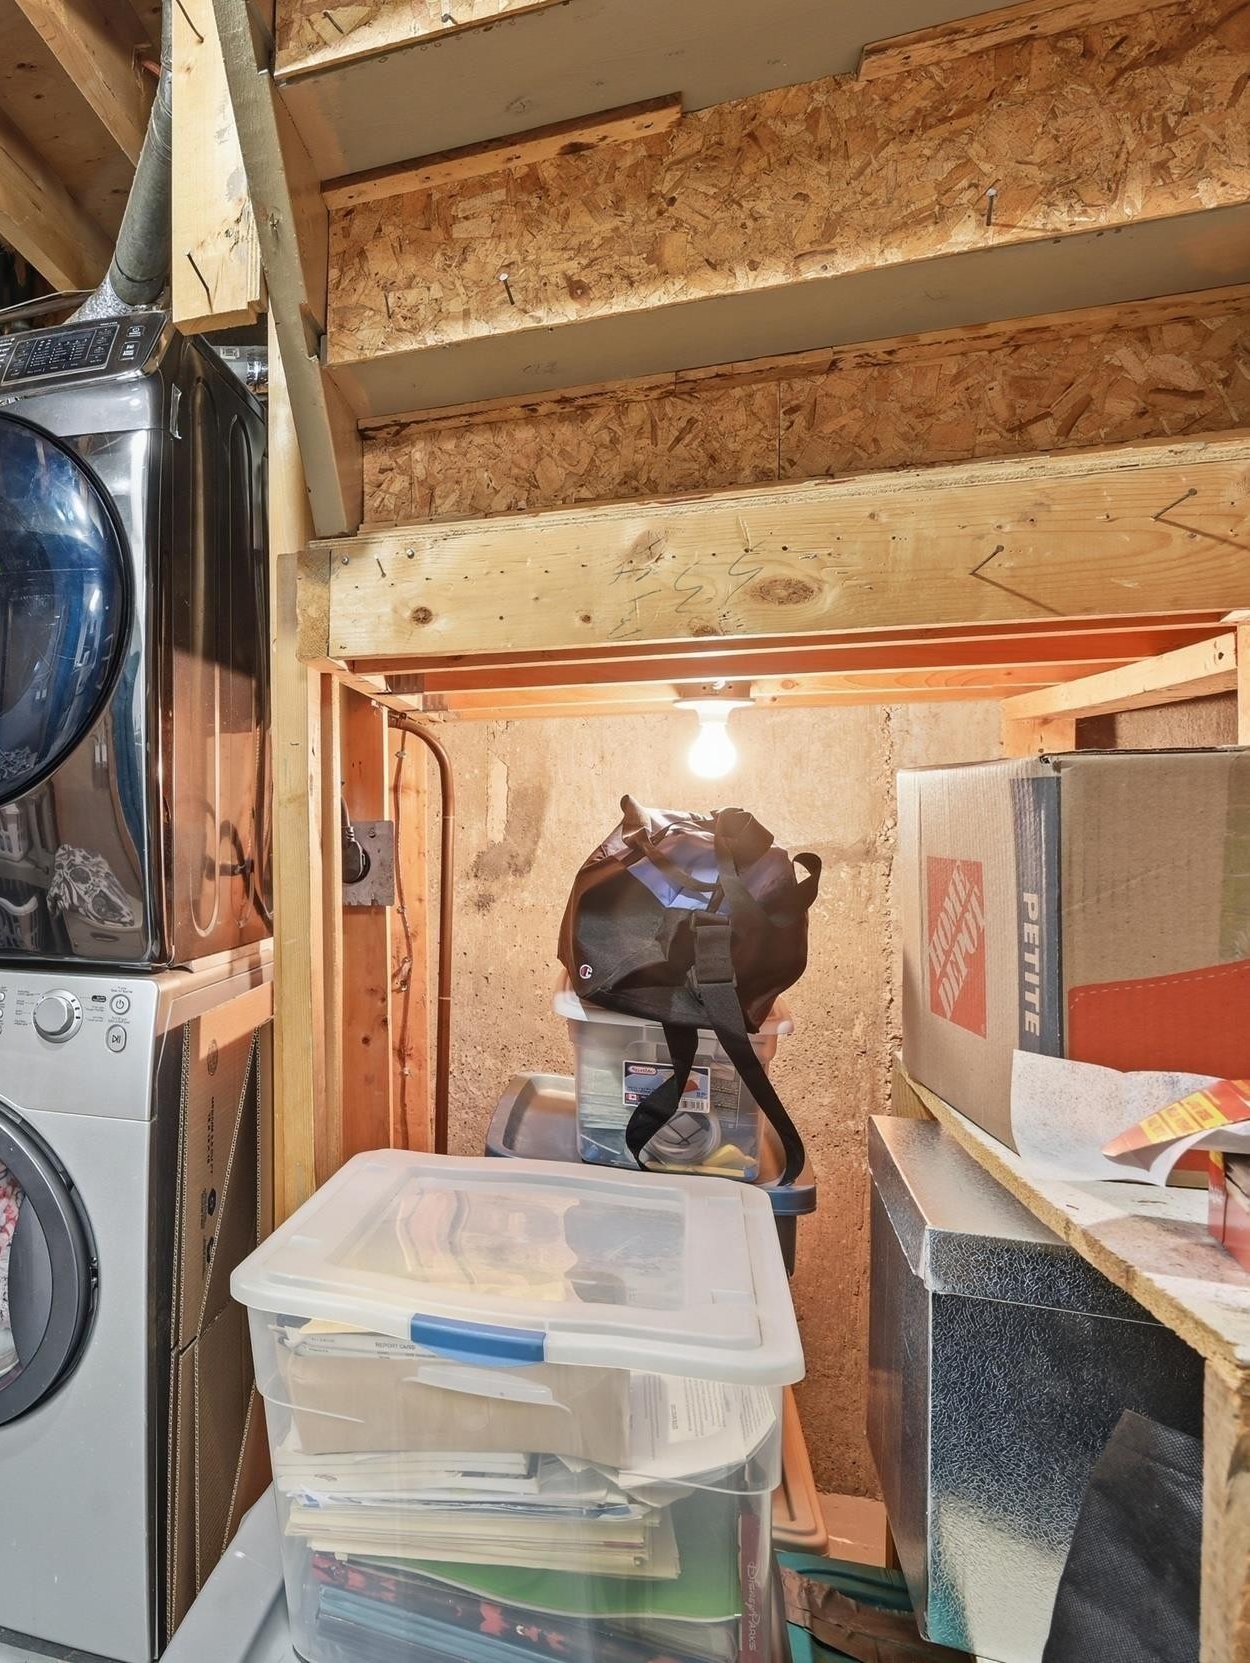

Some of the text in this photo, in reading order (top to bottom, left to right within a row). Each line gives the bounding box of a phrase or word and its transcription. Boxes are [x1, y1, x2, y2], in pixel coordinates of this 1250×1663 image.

[928, 860, 971, 979] HOME
[938, 884, 985, 1020] DEPOT
[1023, 891, 1040, 1037] PETITE
